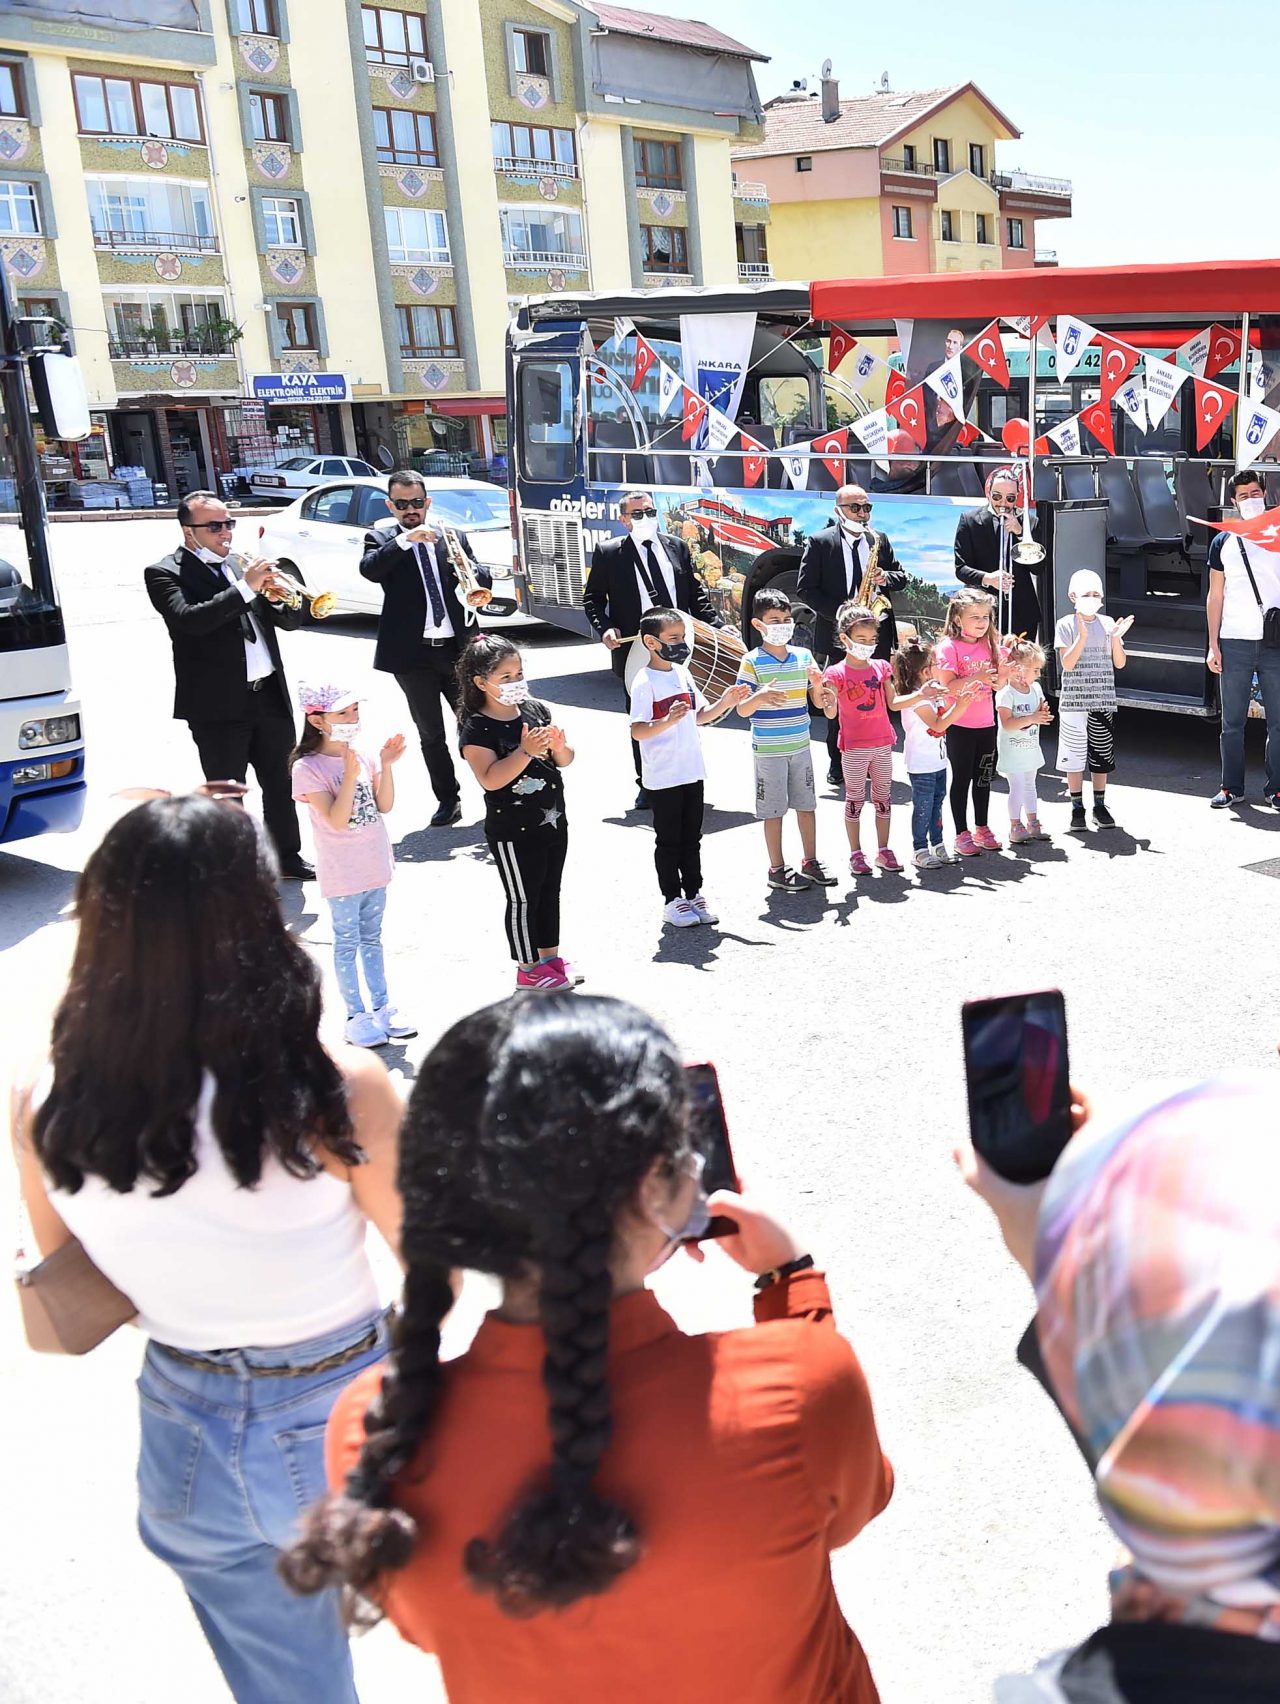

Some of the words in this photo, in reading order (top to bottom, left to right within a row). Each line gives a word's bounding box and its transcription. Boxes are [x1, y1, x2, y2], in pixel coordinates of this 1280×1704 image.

[697, 360, 742, 370] ANKARA
[1156, 369, 1173, 380] ANKARA
[281, 375, 318, 386] KAYA
[257, 387, 304, 397] ELEKTRONİK
[309, 385, 344, 396] ELEKTRİK
[550, 493, 604, 519] gözler
